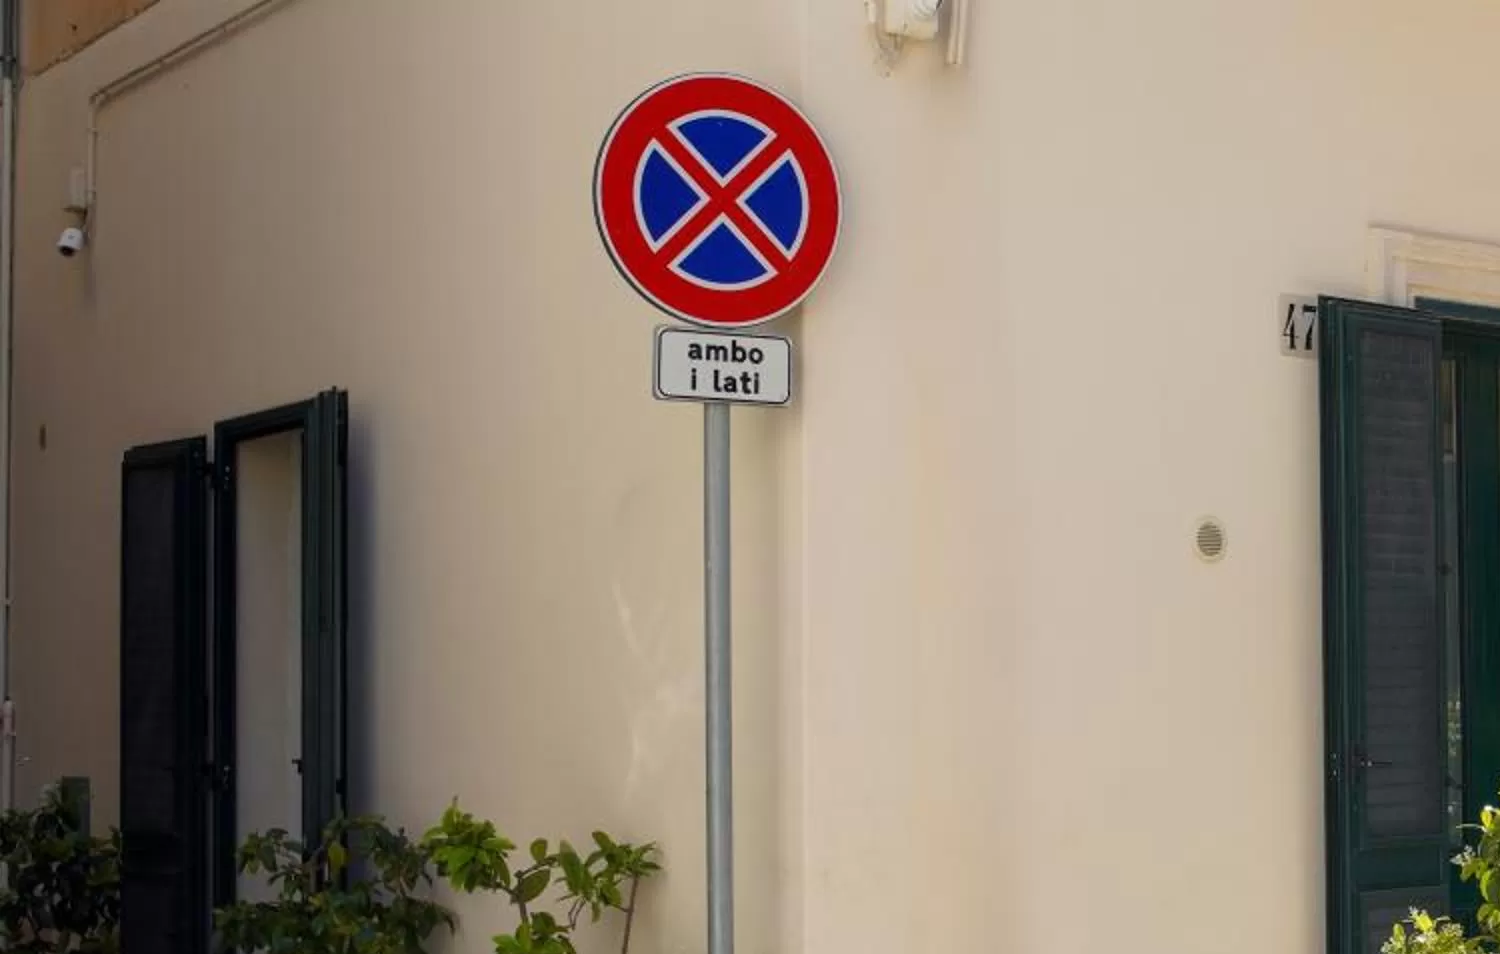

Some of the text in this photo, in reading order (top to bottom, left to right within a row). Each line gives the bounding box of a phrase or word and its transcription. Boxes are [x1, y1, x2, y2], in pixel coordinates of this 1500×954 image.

[1283, 303, 1317, 351] 47
[687, 340, 764, 364] ambo
[691, 368, 759, 394] i lati
